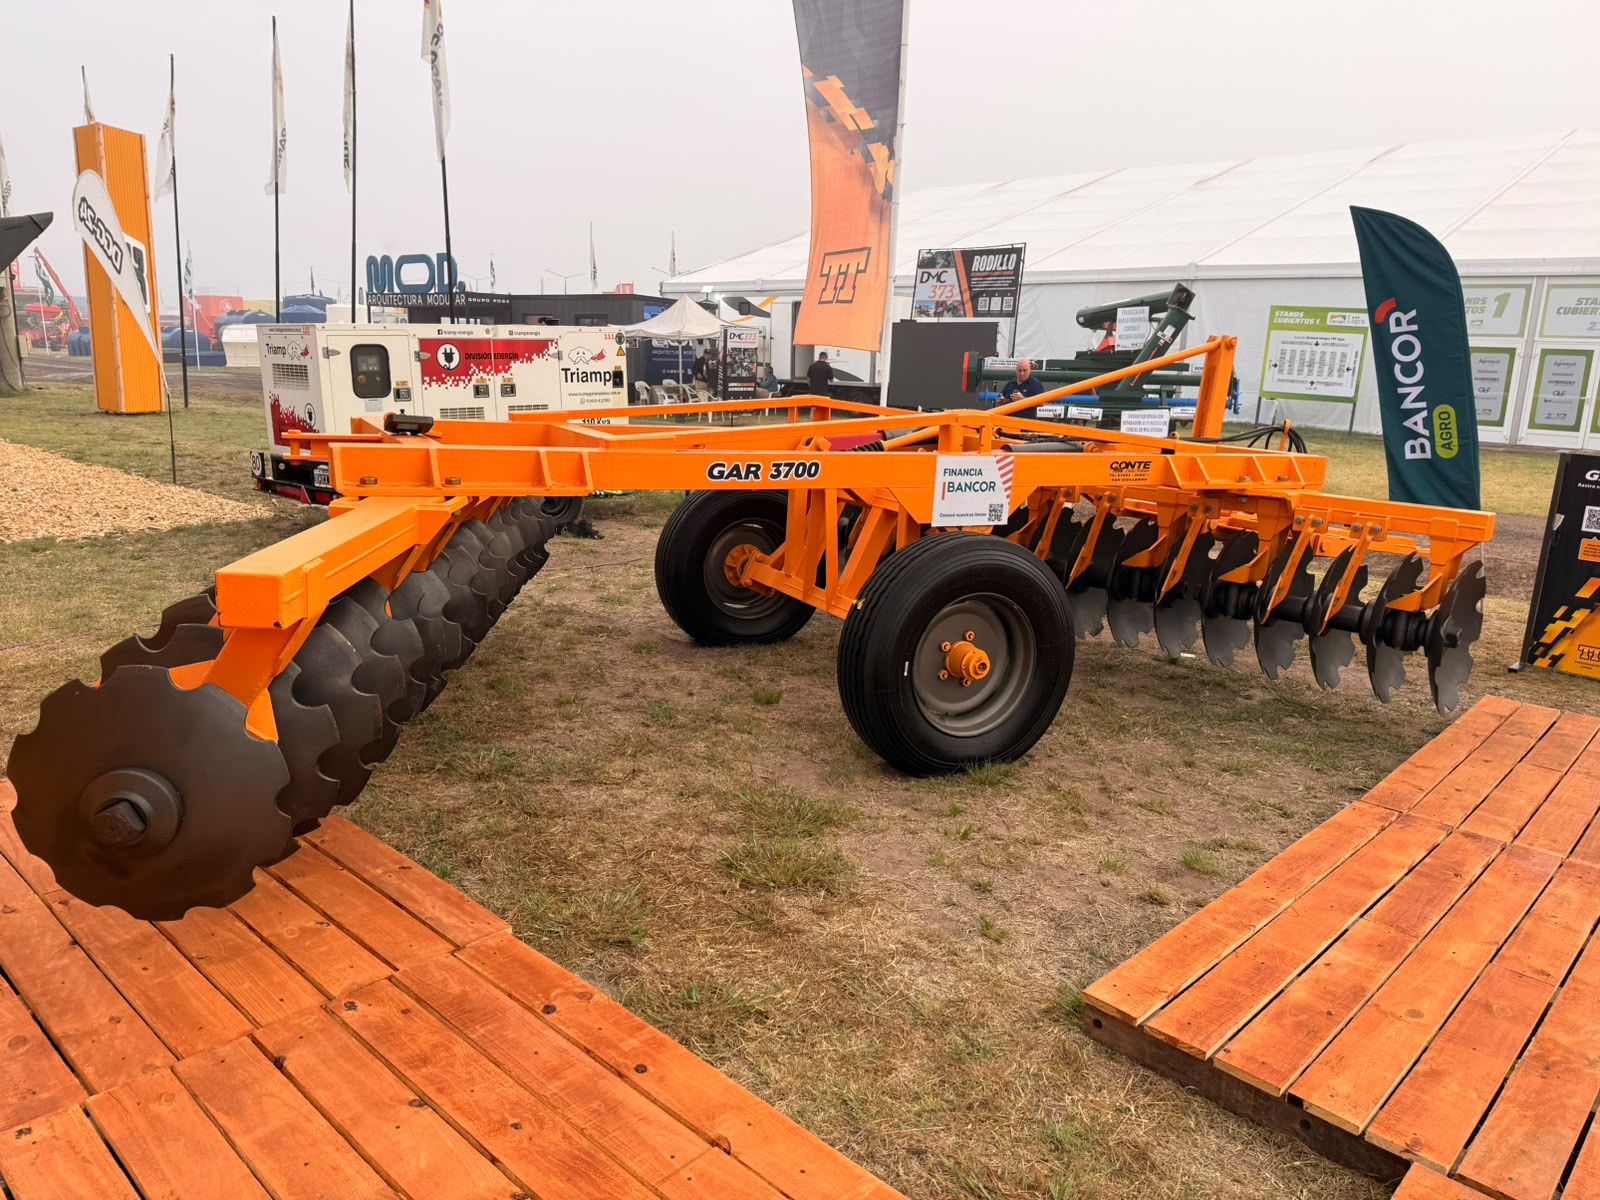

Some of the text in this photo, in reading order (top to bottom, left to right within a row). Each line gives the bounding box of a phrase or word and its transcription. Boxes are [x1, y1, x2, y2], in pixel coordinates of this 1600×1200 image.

[971, 253, 1017, 272] RODILLO
[367, 293, 423, 306] ARQUITECTURA
[426, 293, 466, 306] MODUAR
[927, 284, 957, 300] 373
[1492, 292, 1512, 319] 1
[1273, 317, 1315, 325] CUBIERTOS
[1274, 310, 1304, 318] STANDS
[265, 343, 287, 358] Triamp
[561, 367, 612, 387] Triamp
[1389, 308, 1432, 460] BANCOR
[1438, 410, 1454, 451] AGRO
[705, 460, 821, 481] GAR 3700
[943, 468, 983, 477] FINANCIA
[1109, 460, 1152, 470] CONTE
[947, 481, 996, 493] BANCOR
